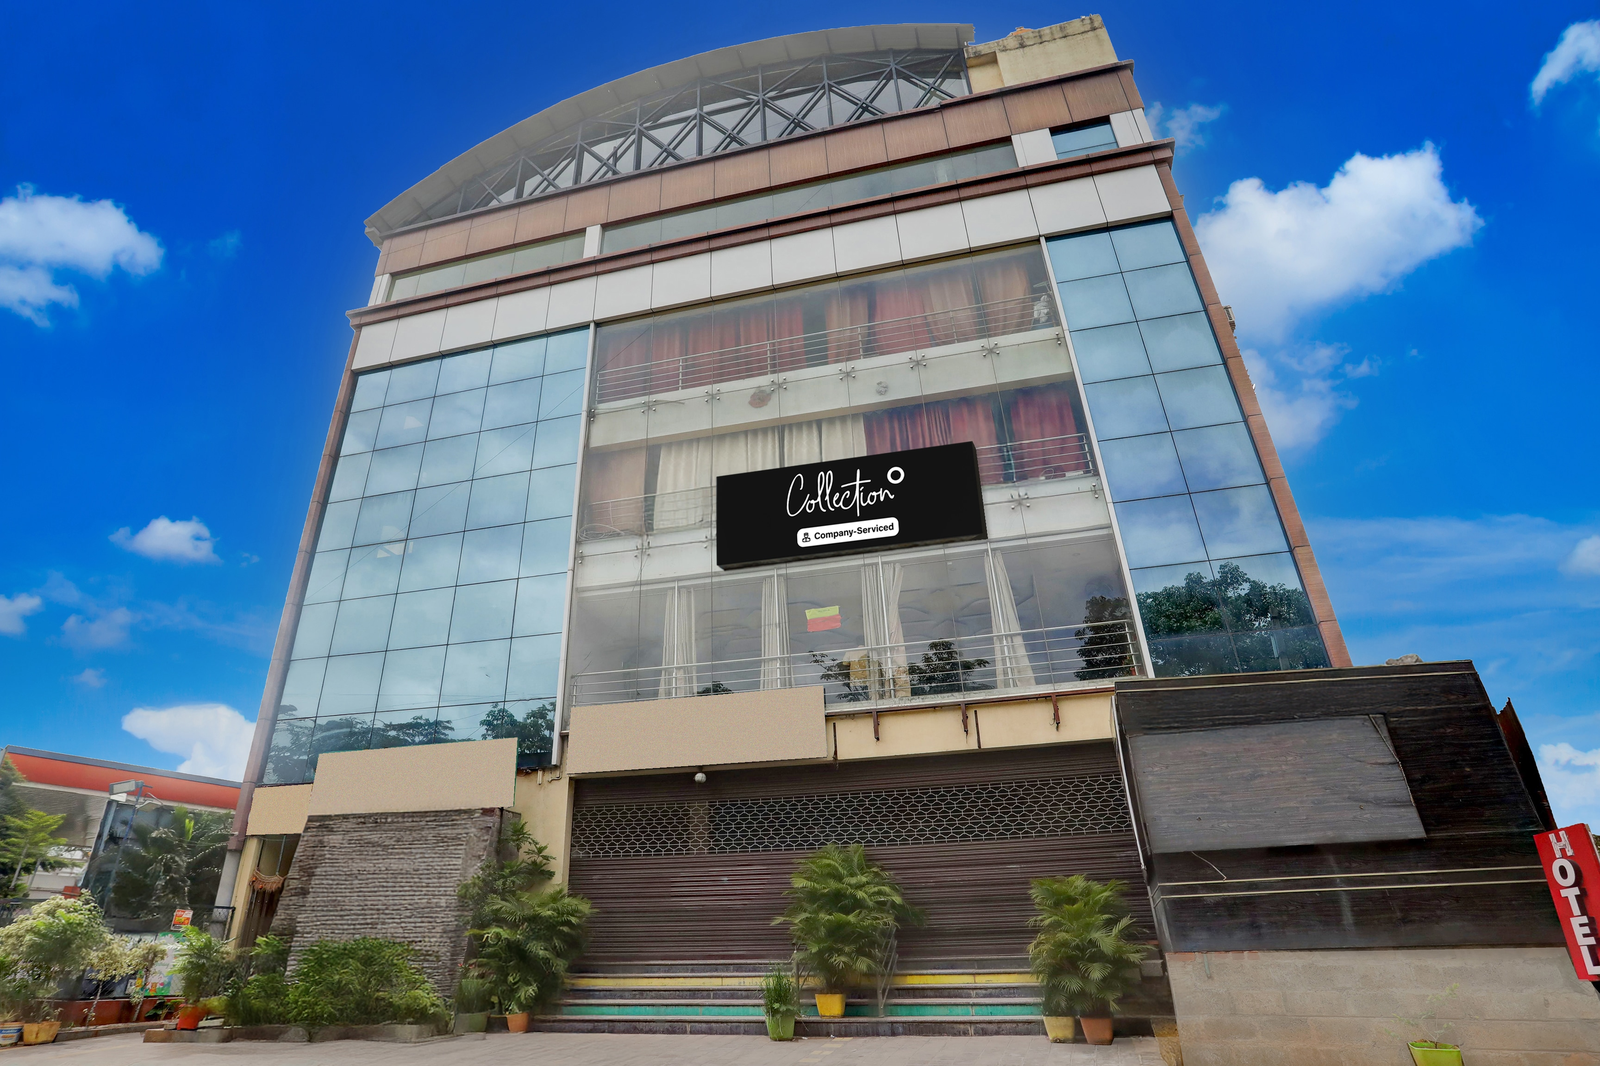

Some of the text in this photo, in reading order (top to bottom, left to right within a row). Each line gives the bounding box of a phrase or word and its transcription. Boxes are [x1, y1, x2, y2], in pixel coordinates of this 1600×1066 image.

[786, 468, 895, 517] Collection
[814, 522, 894, 540] Company-Serviced
[1549, 830, 1600, 975] HOTEL
